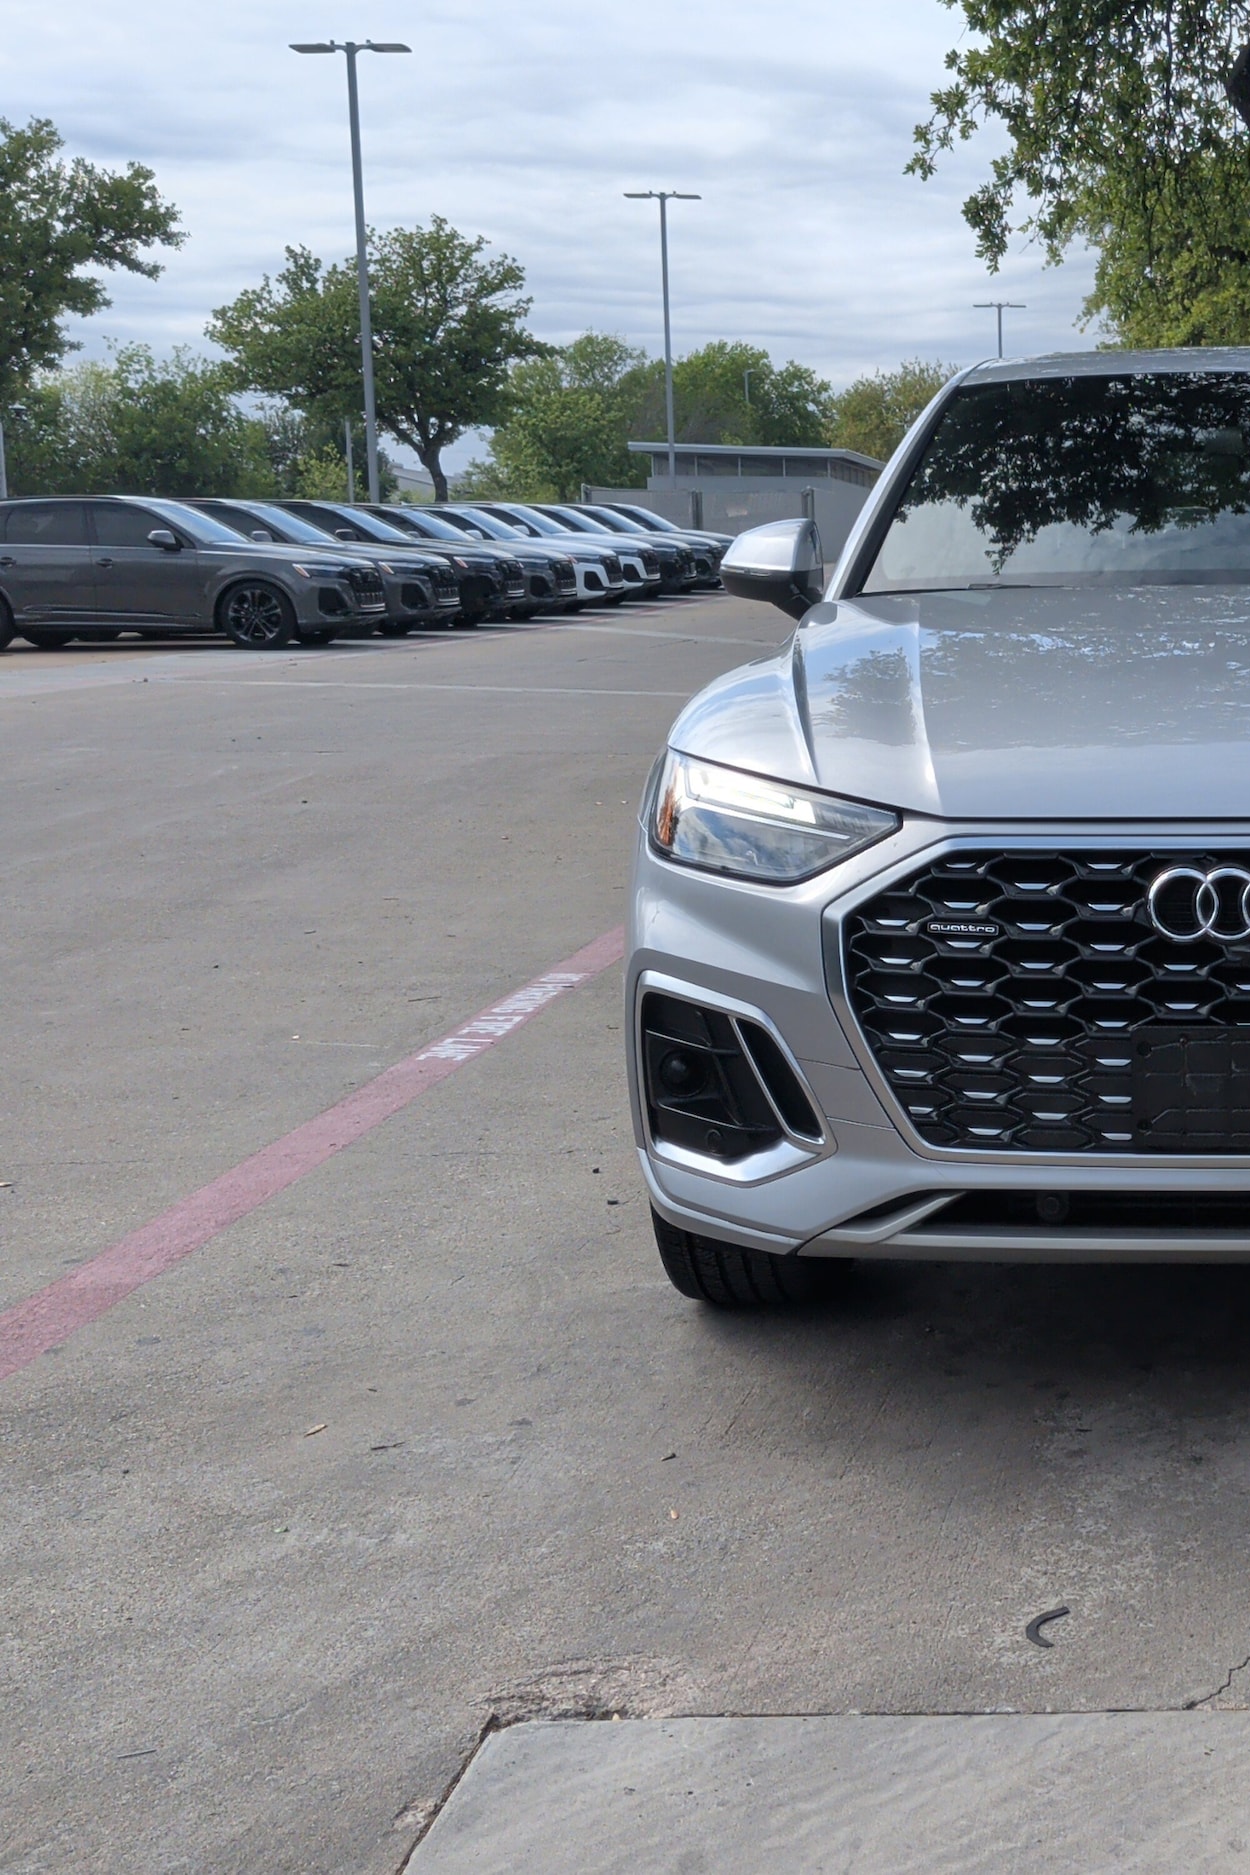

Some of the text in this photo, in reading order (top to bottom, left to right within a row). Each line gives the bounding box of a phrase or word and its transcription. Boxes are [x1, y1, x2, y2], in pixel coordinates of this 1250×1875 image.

[930, 924, 995, 933] quattro
[458, 1016, 524, 1036] FIRE
[415, 1038, 494, 1061] LANE
